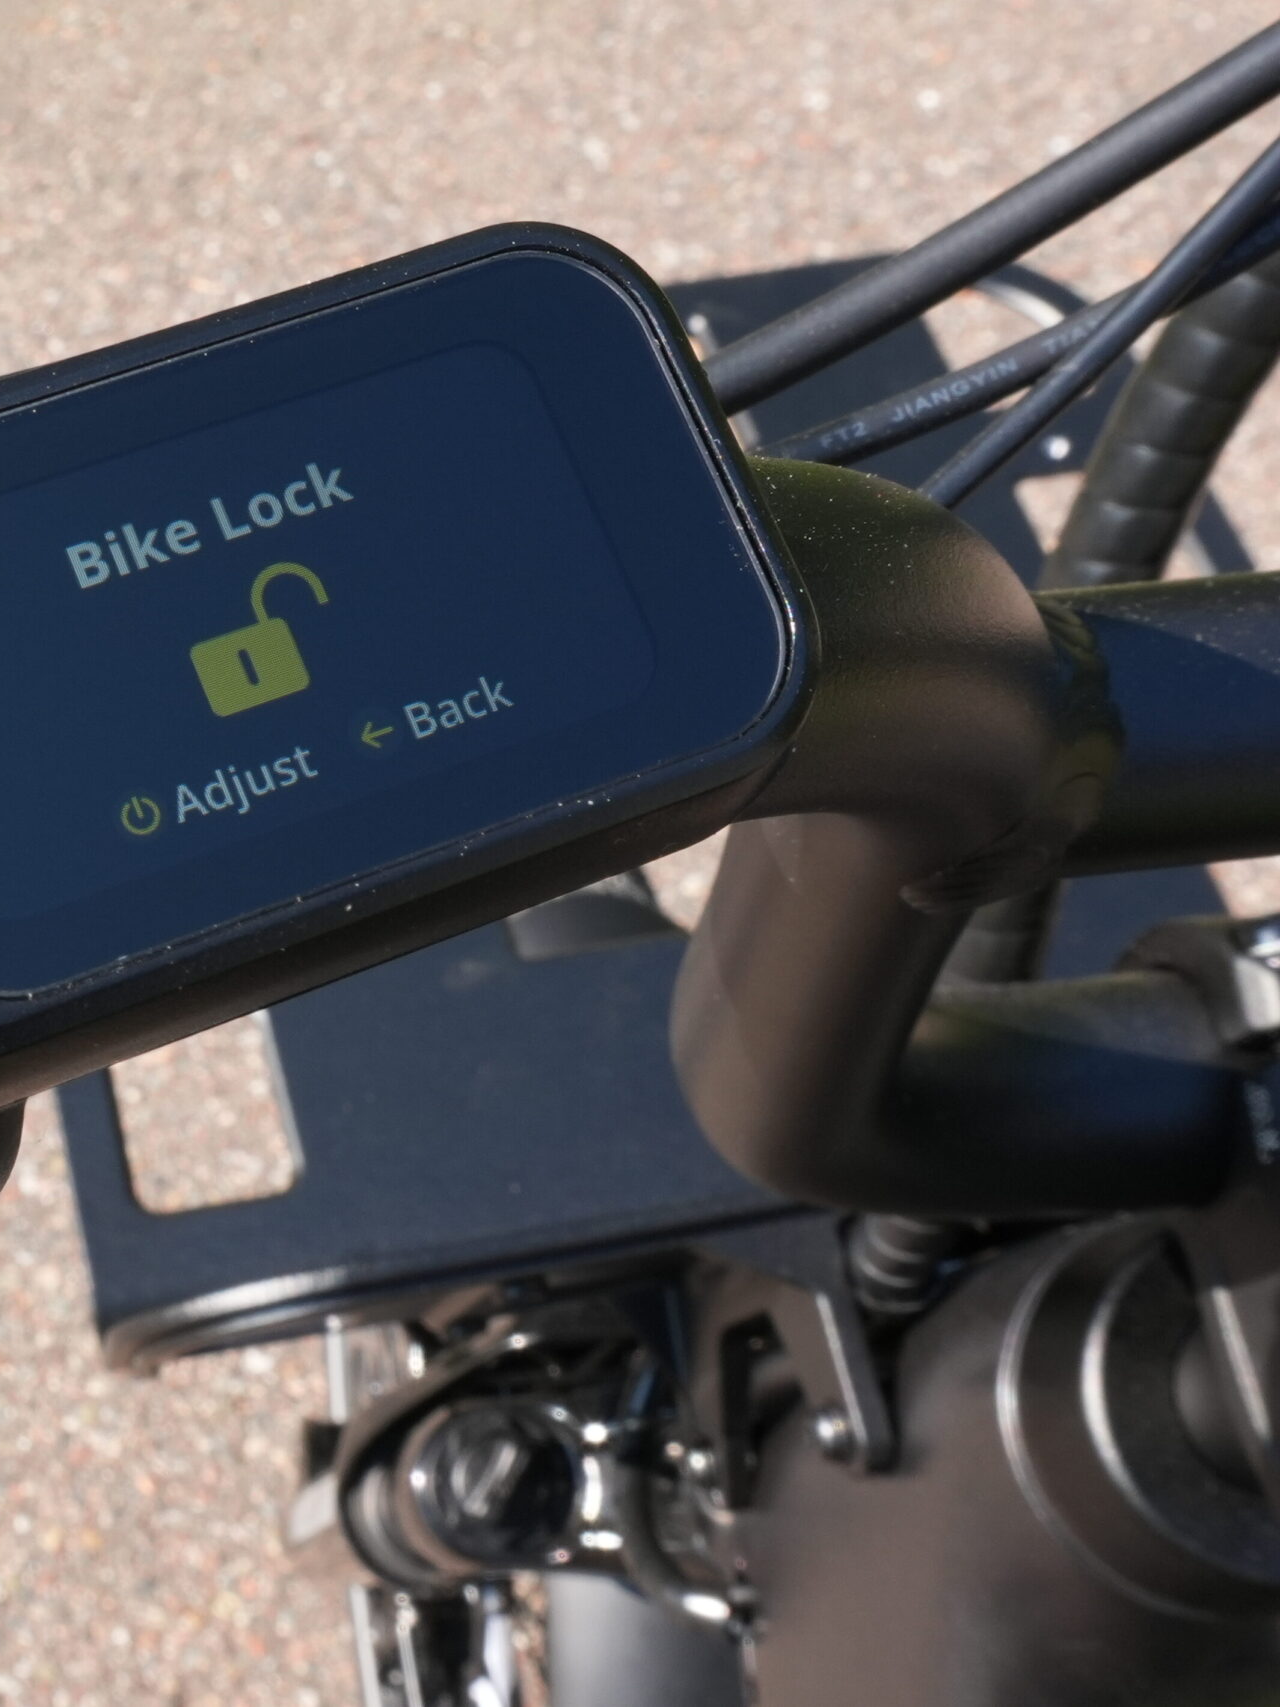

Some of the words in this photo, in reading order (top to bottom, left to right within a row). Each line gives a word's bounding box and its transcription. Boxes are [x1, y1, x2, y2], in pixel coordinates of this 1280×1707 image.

[890, 356, 1019, 423] JIANGYIN
[65, 518, 201, 589] Bike
[210, 461, 355, 541] Lock
[402, 675, 515, 740] Back
[176, 744, 320, 825] Adjust
